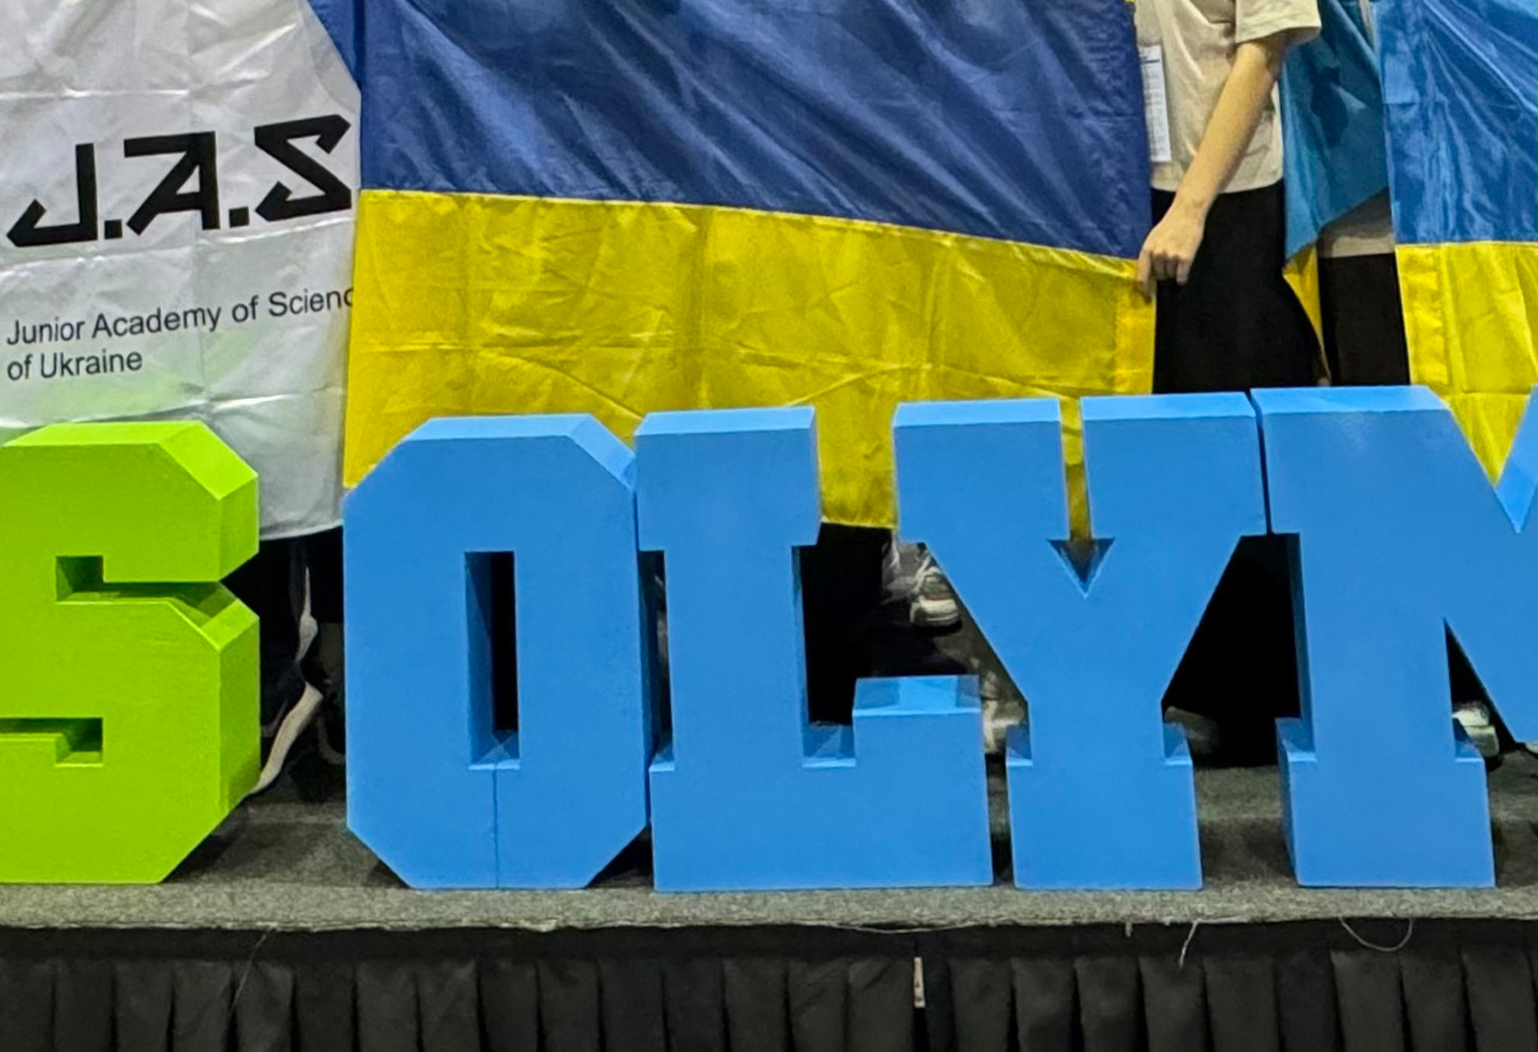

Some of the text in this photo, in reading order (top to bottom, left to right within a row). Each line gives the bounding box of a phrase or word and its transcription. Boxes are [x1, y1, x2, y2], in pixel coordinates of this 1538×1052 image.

[6, 316, 87, 346] Junior
[92, 306, 221, 341] Academy
[231, 295, 260, 324] of
[6, 348, 143, 382] of Ukraine
